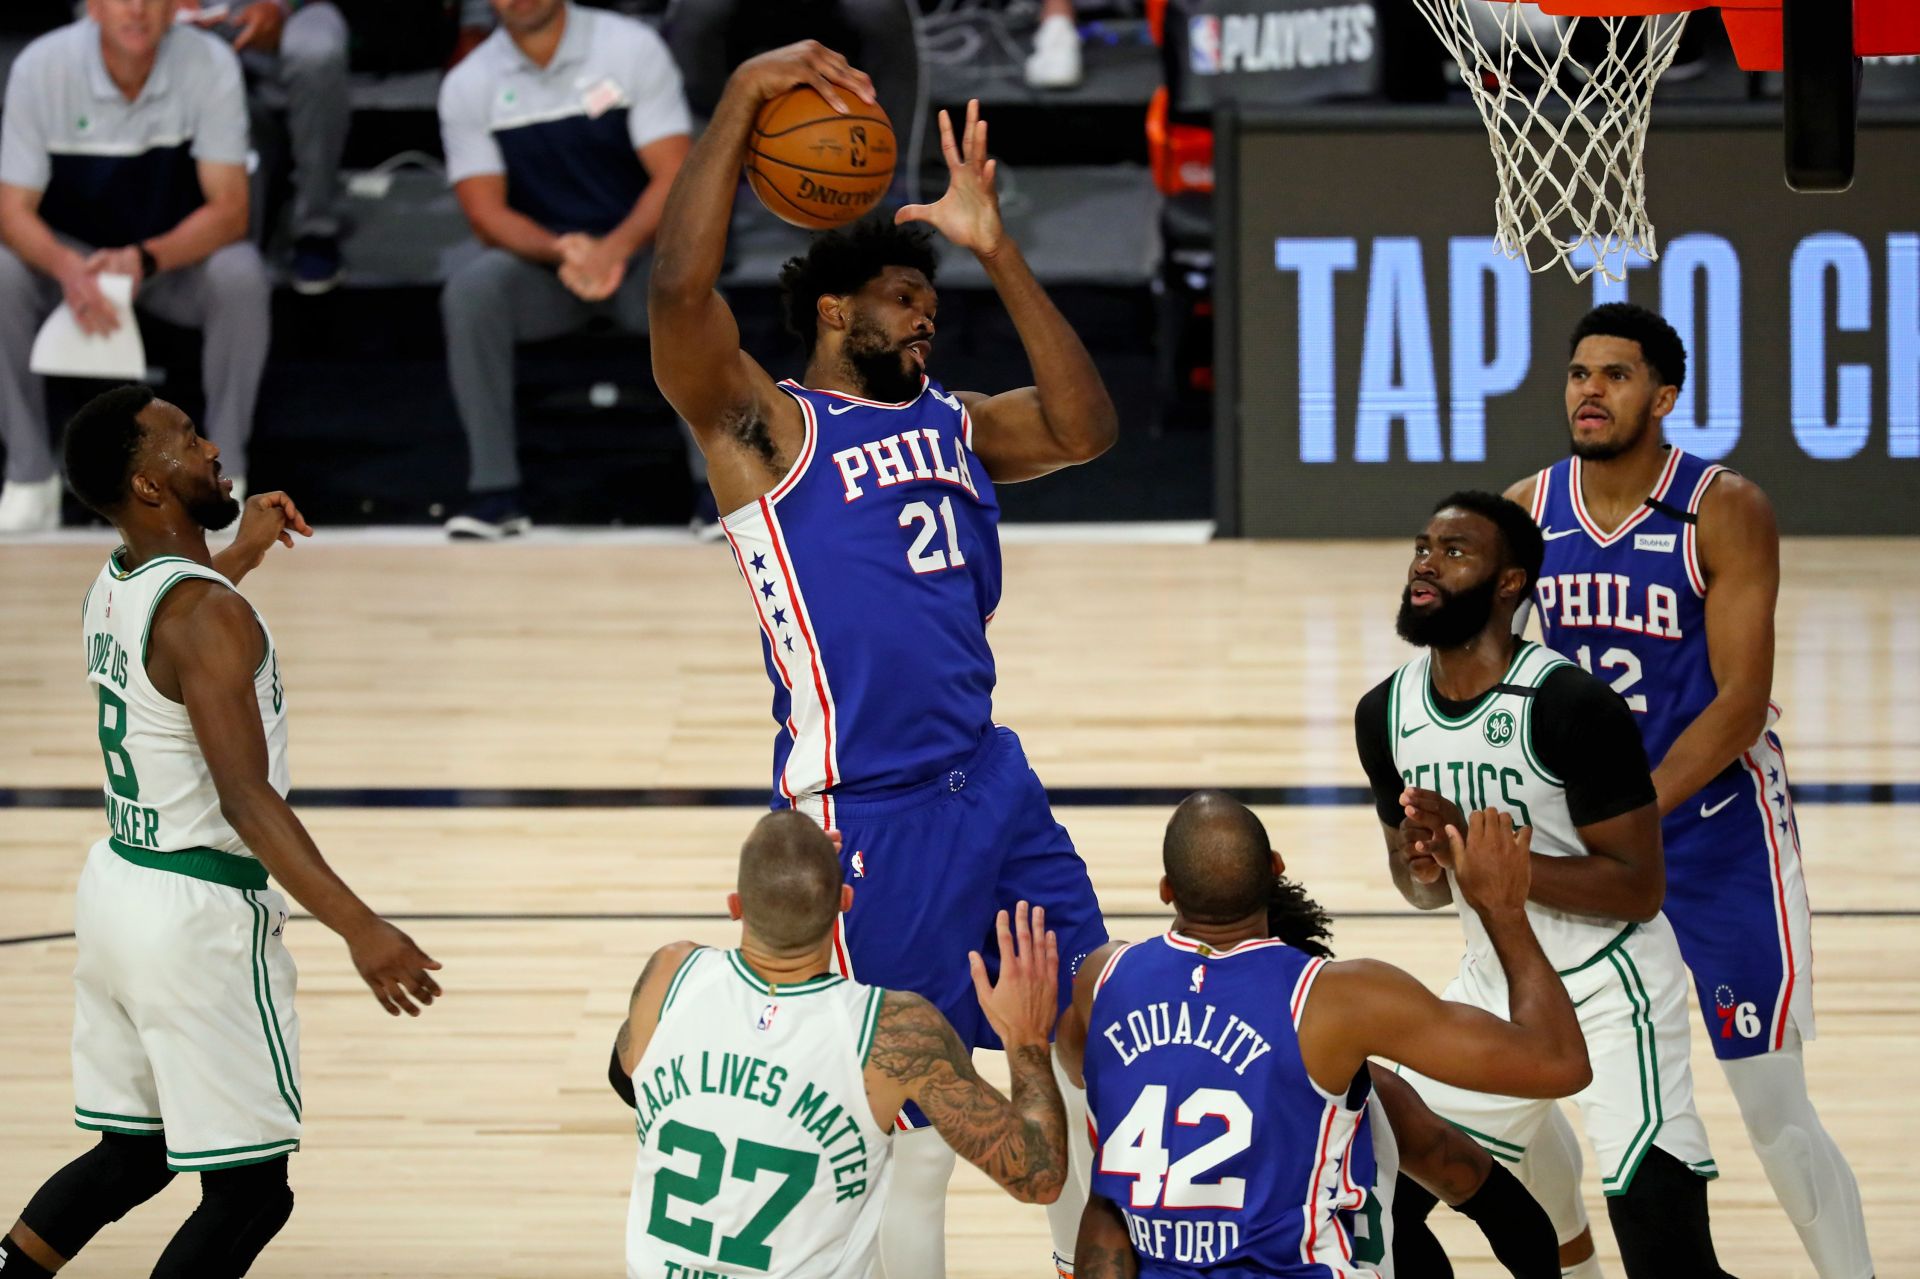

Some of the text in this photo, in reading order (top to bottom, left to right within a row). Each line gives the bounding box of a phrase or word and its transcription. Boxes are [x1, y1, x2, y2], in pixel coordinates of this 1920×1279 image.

[1222, 4, 1375, 72] PLAYOFFS
[796, 174, 883, 206] ALDING
[1275, 235, 1532, 463] TAP
[831, 428, 979, 503] PHILA
[898, 496, 965, 574] 21
[1639, 538, 1671, 548] StubHub
[1536, 573, 1682, 640] PHILA
[111, 641, 128, 690] US
[105, 794, 160, 848] ALKER
[1402, 762, 1533, 832] TICS
[1104, 1001, 1271, 1076] EQUALITY
[1715, 1002, 1761, 1038] 76
[635, 1051, 867, 1204] BLACK LIVES MATTER
[1100, 1084, 1253, 1209] 42
[646, 1119, 820, 1271] 27
